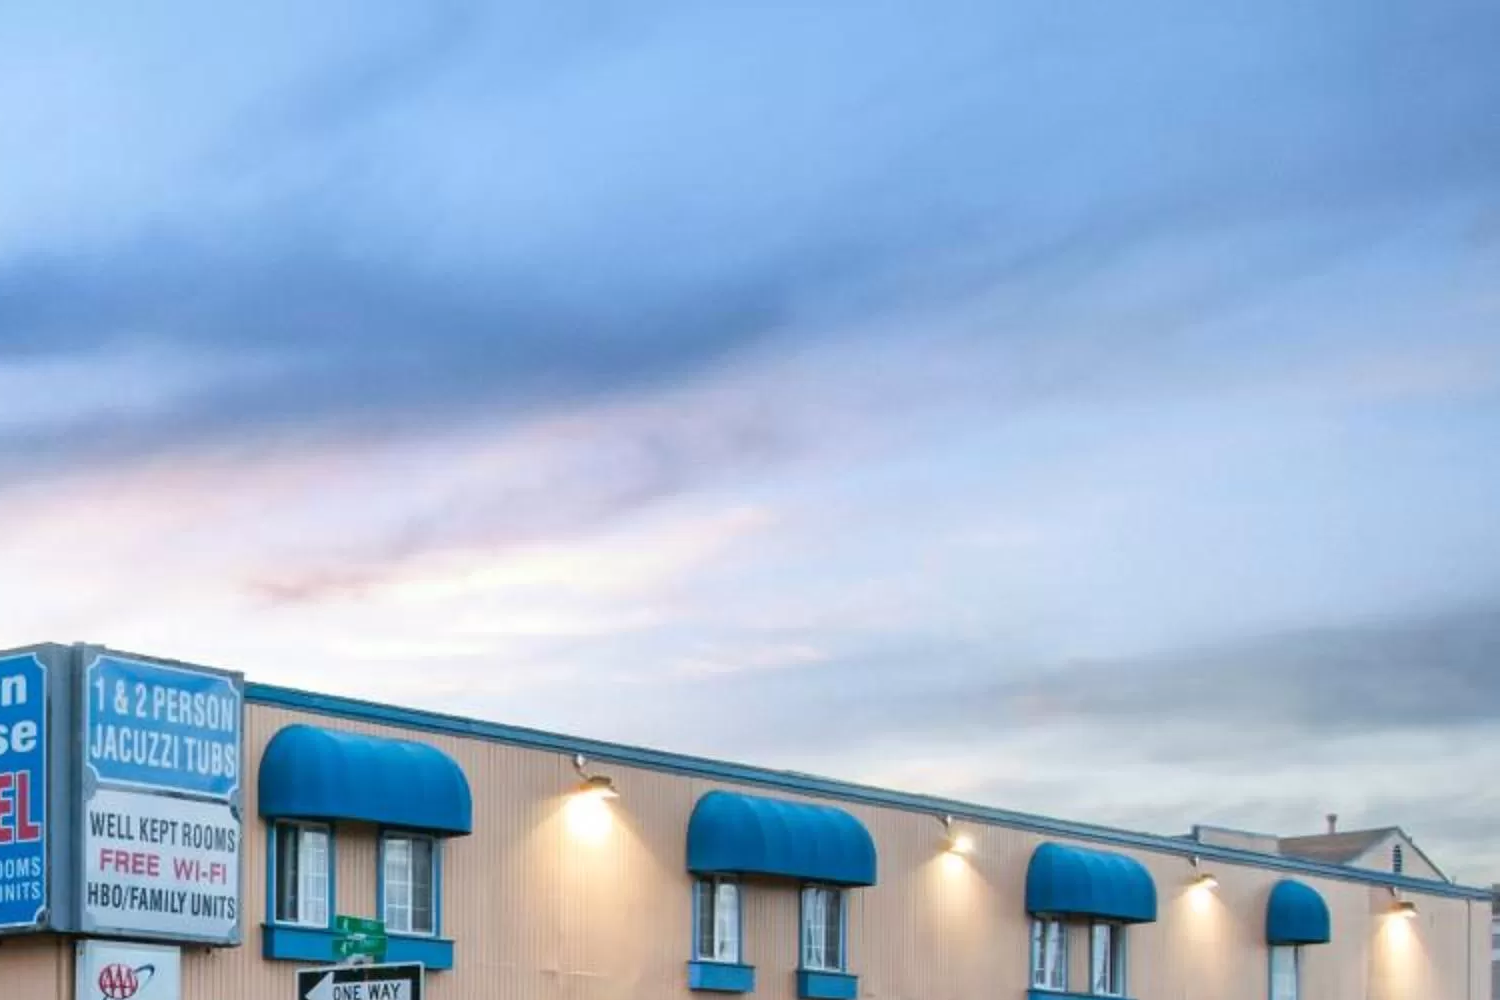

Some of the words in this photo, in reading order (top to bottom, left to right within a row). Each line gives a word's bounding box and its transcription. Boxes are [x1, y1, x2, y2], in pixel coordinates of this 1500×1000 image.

[93, 678, 105, 713] 1
[113, 679, 129, 716] &
[135, 683, 148, 719] 2
[153, 684, 234, 733] PERSON
[92, 723, 179, 770] JACUZZI
[186, 736, 236, 779] TUBS
[89, 810, 135, 841] WELL
[139, 816, 178, 846] KEPT
[182, 822, 236, 853] ROOMS
[99, 847, 160, 878] FREE
[173, 856, 227, 886] WI-FI
[88, 881, 187, 916] HBO/FAMILY
[191, 894, 236, 921] UNITS
[99, 964, 138, 1000] AAA
[367, 983, 402, 1000] WAY
